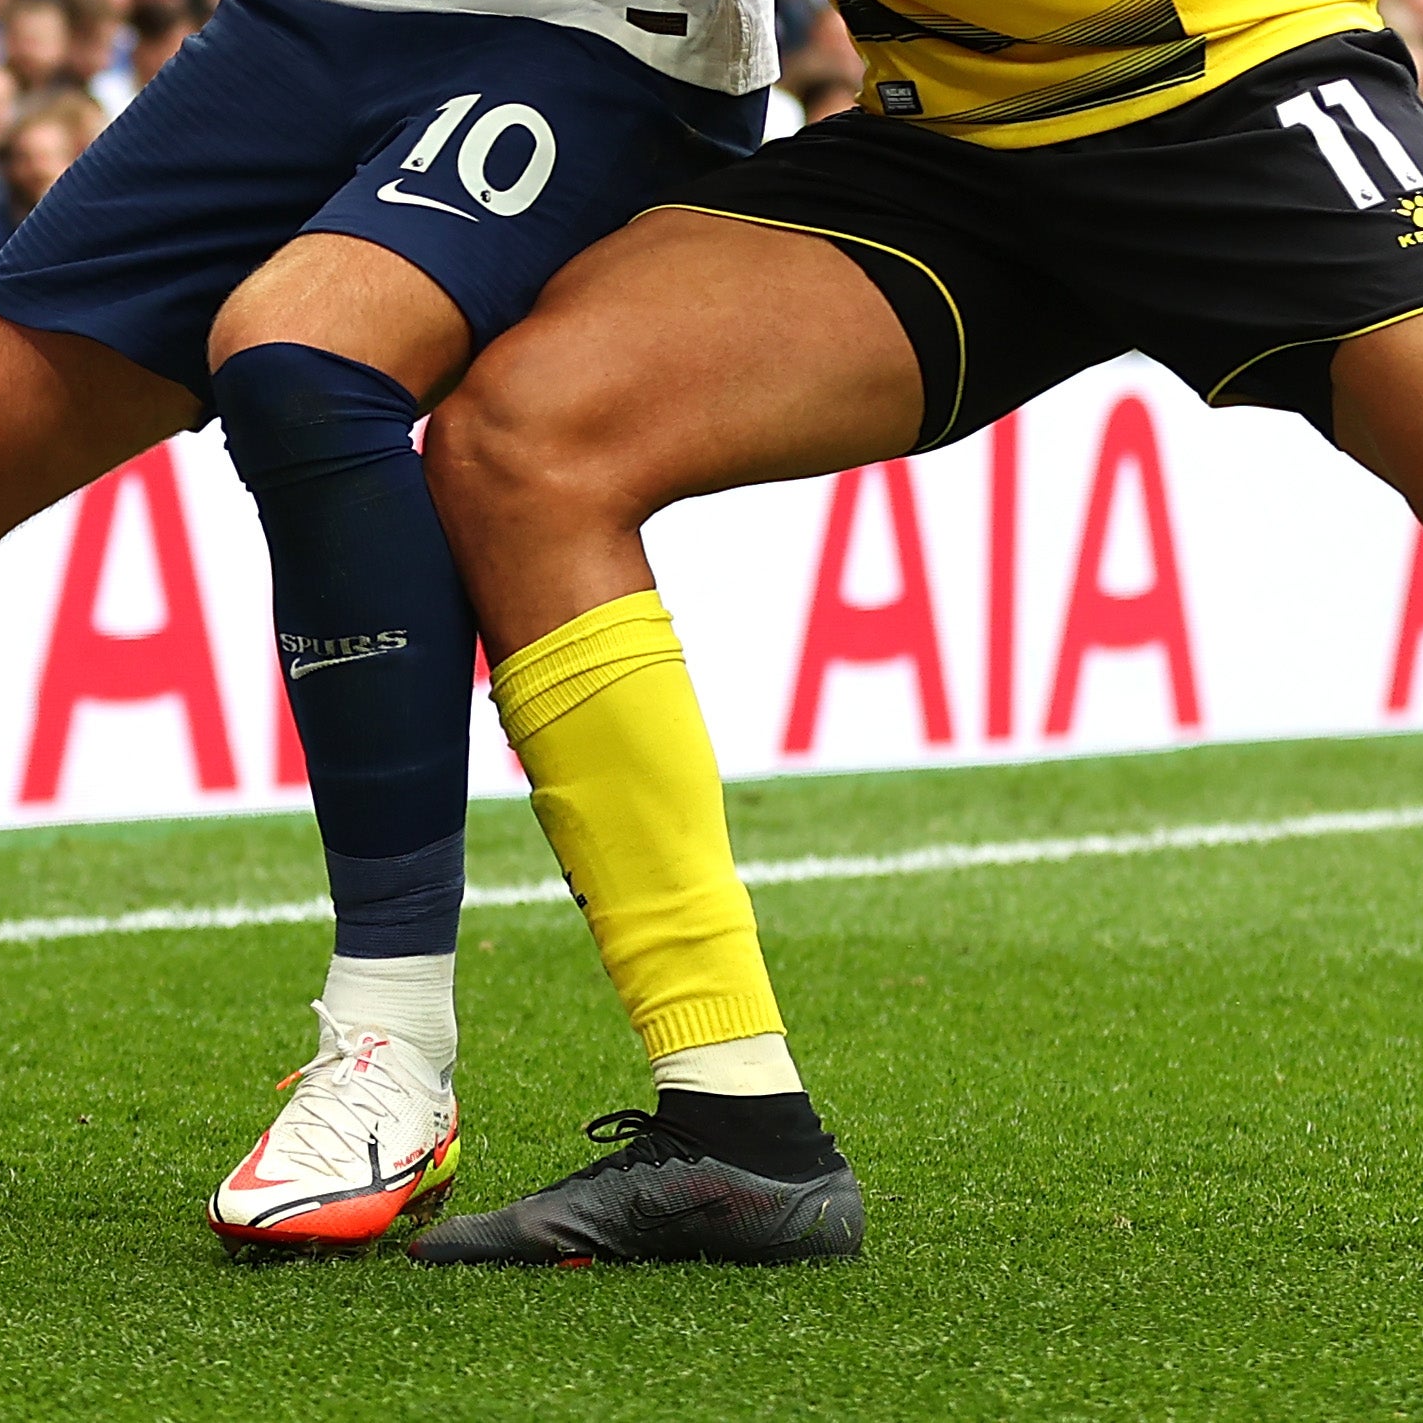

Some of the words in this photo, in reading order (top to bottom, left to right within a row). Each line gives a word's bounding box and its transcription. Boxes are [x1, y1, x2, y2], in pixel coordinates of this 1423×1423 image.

[400, 93, 557, 217] 10
[780, 394, 1203, 757] AIA
[279, 628, 408, 657] SPURS
